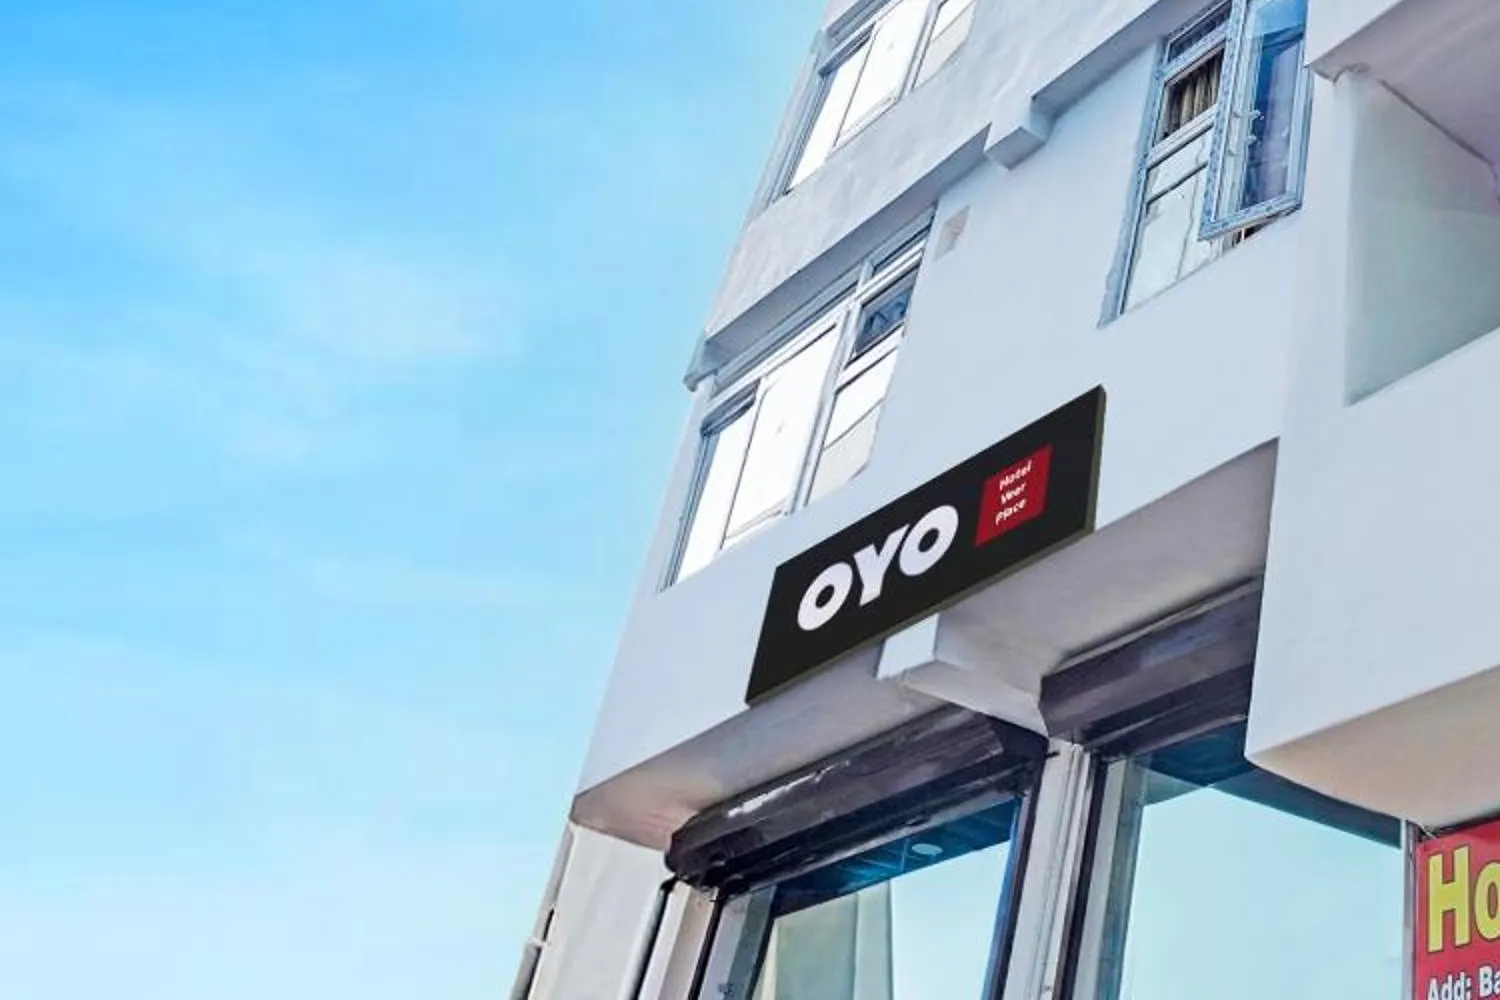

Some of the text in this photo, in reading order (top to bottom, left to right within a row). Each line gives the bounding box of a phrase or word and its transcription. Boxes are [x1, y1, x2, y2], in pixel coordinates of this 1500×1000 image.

[999, 459, 1032, 490] Hotel
[995, 499, 1026, 526] Place
[797, 505, 959, 631] OYO
